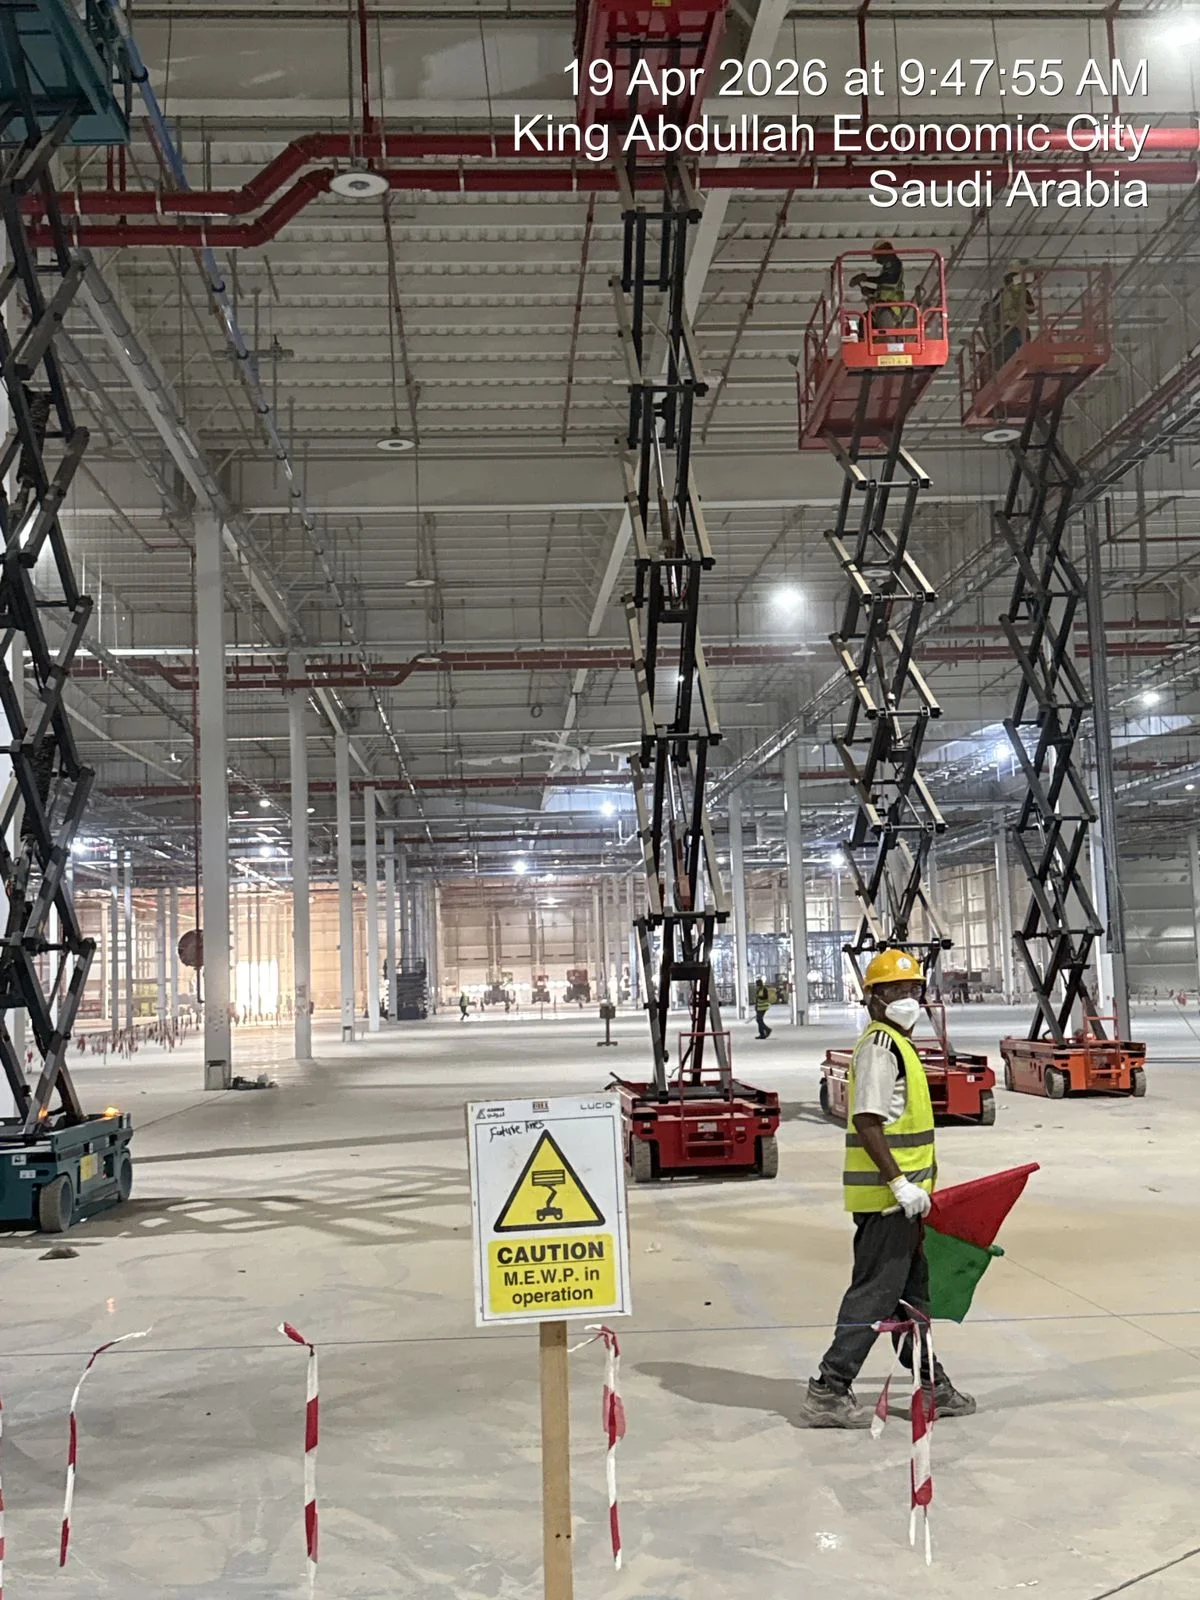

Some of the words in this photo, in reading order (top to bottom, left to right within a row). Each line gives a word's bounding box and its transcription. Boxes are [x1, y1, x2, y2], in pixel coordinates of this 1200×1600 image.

[580, 1101, 615, 1111] LUCID
[497, 1241, 604, 1265] CAUTION
[504, 1268, 580, 1286] M.E.W.P.
[584, 1266, 600, 1281] in
[512, 1287, 593, 1308] operation
